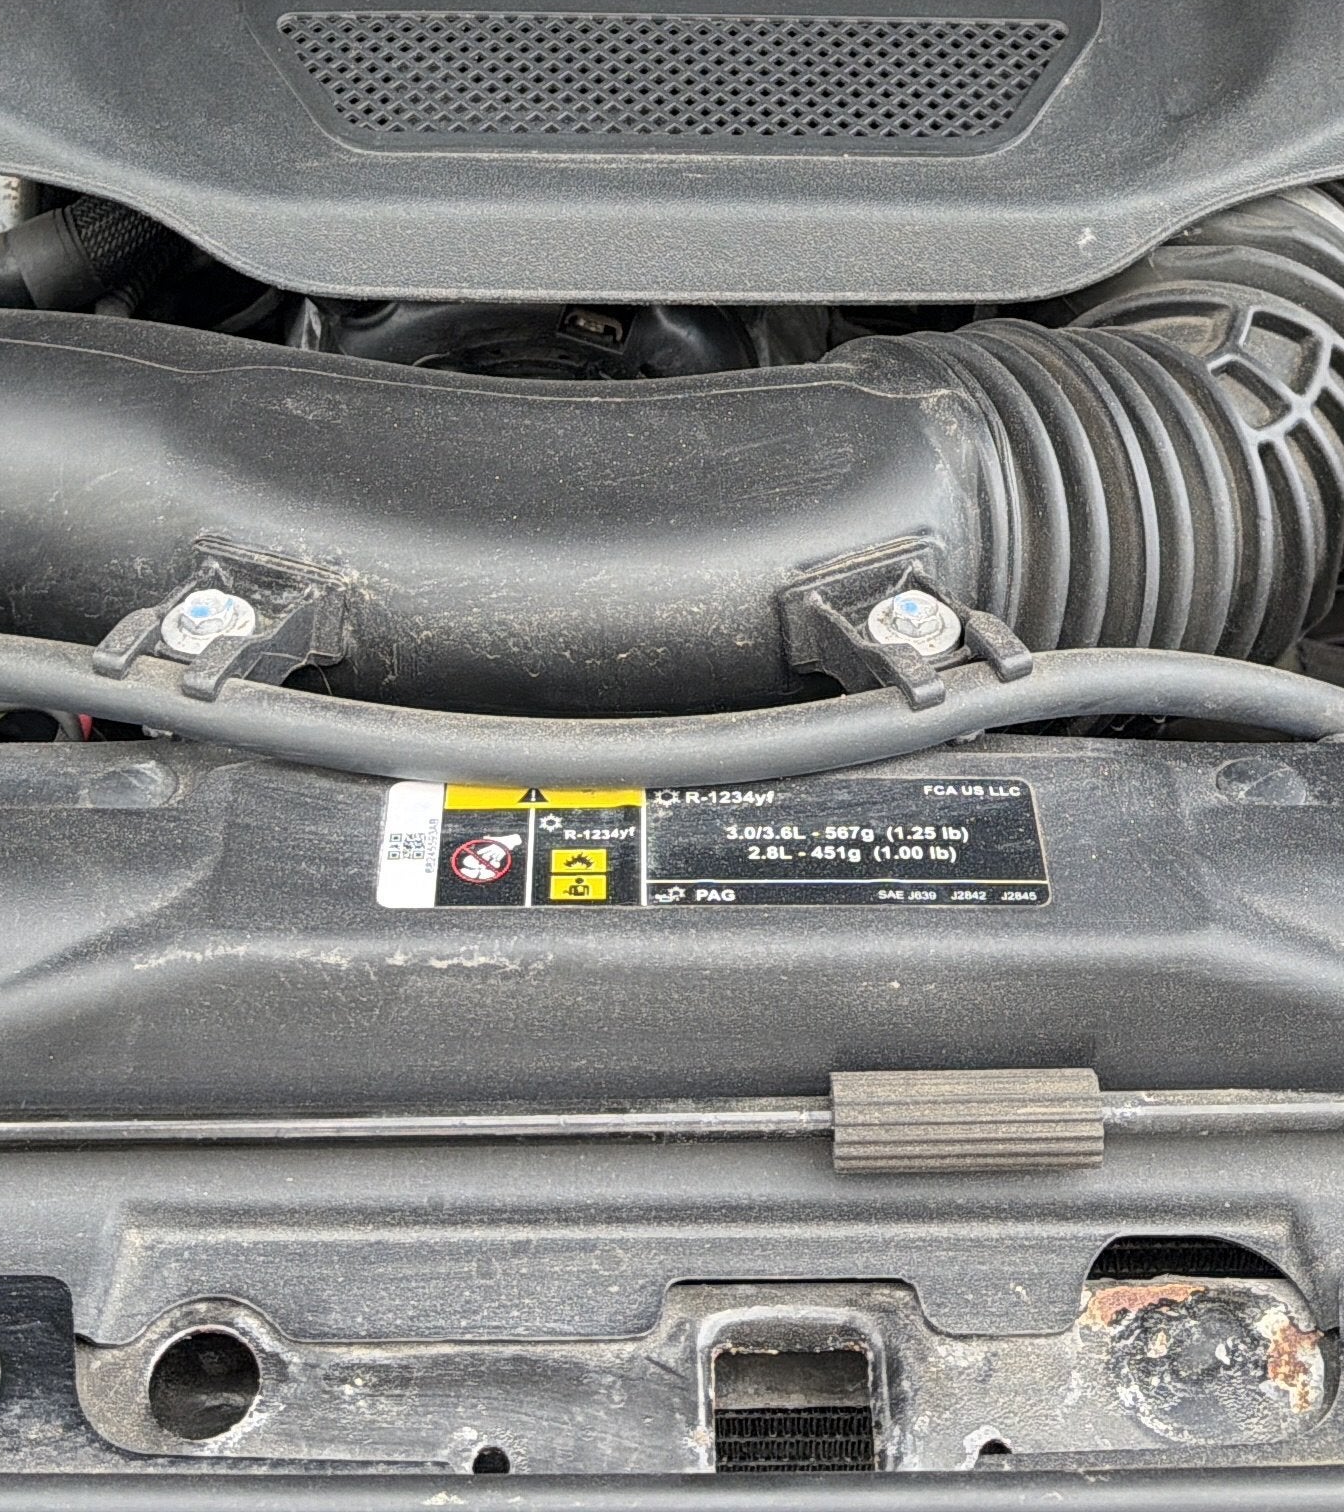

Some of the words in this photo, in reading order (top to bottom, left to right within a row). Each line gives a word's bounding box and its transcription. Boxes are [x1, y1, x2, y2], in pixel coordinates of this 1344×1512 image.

[685, 788, 775, 804] R-1234yf
[923, 785, 957, 797] FCA
[962, 785, 985, 797] US
[989, 786, 1021, 797] LLC
[564, 825, 637, 842] R-1234yf
[726, 826, 806, 841] 3.0/3.6L
[825, 827, 875, 842] 567g
[886, 826, 936, 842] (1.25
[943, 826, 970, 842] lb)
[748, 846, 793, 860] 2.8L
[810, 846, 862, 862] 451g
[874, 846, 924, 862] (1.00
[930, 846, 957, 862] lb)
[696, 888, 737, 903] PAG
[878, 890, 905, 901] SAE
